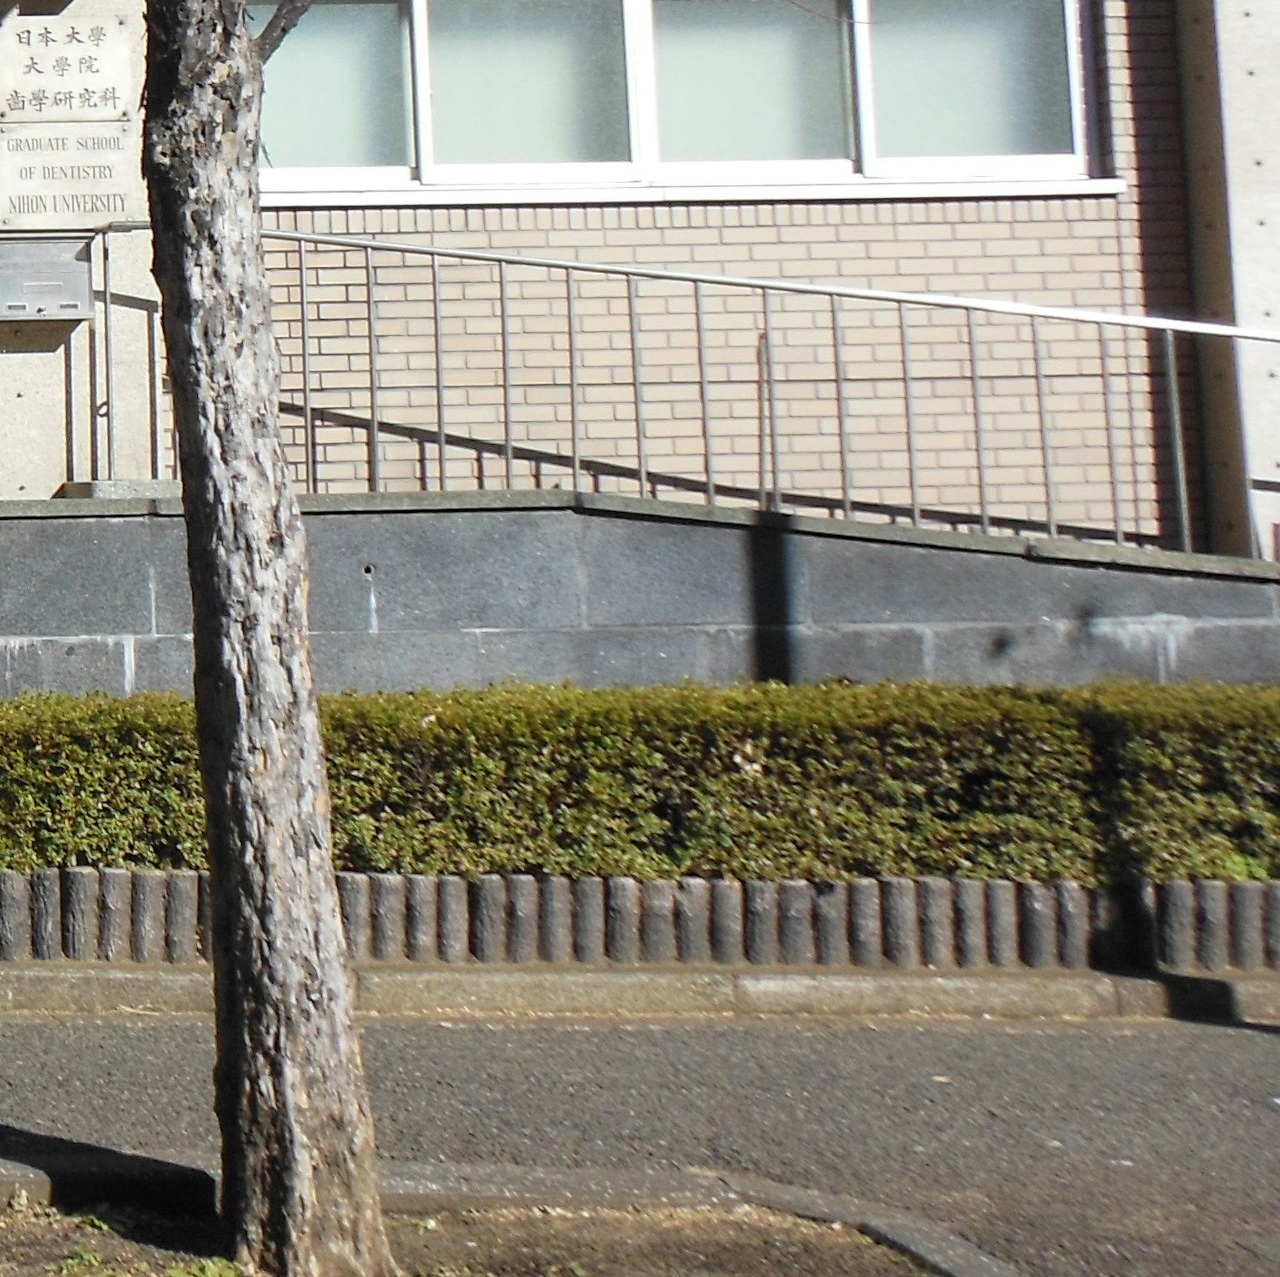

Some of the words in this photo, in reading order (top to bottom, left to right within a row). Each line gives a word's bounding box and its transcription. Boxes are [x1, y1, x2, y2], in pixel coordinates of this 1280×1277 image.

[16, 26, 107, 47] 日本大學
[23, 55, 101, 76] 大學院
[6, 88, 121, 112] 歯學研究科
[7, 138, 69, 153] GRADUATE
[76, 136, 124, 152] SCHOOL
[20, 166, 36, 180] OF
[42, 165, 114, 180] DENTISTRY
[9, 195, 47, 214] NIHON
[53, 194, 127, 214] UNIVERSITY
